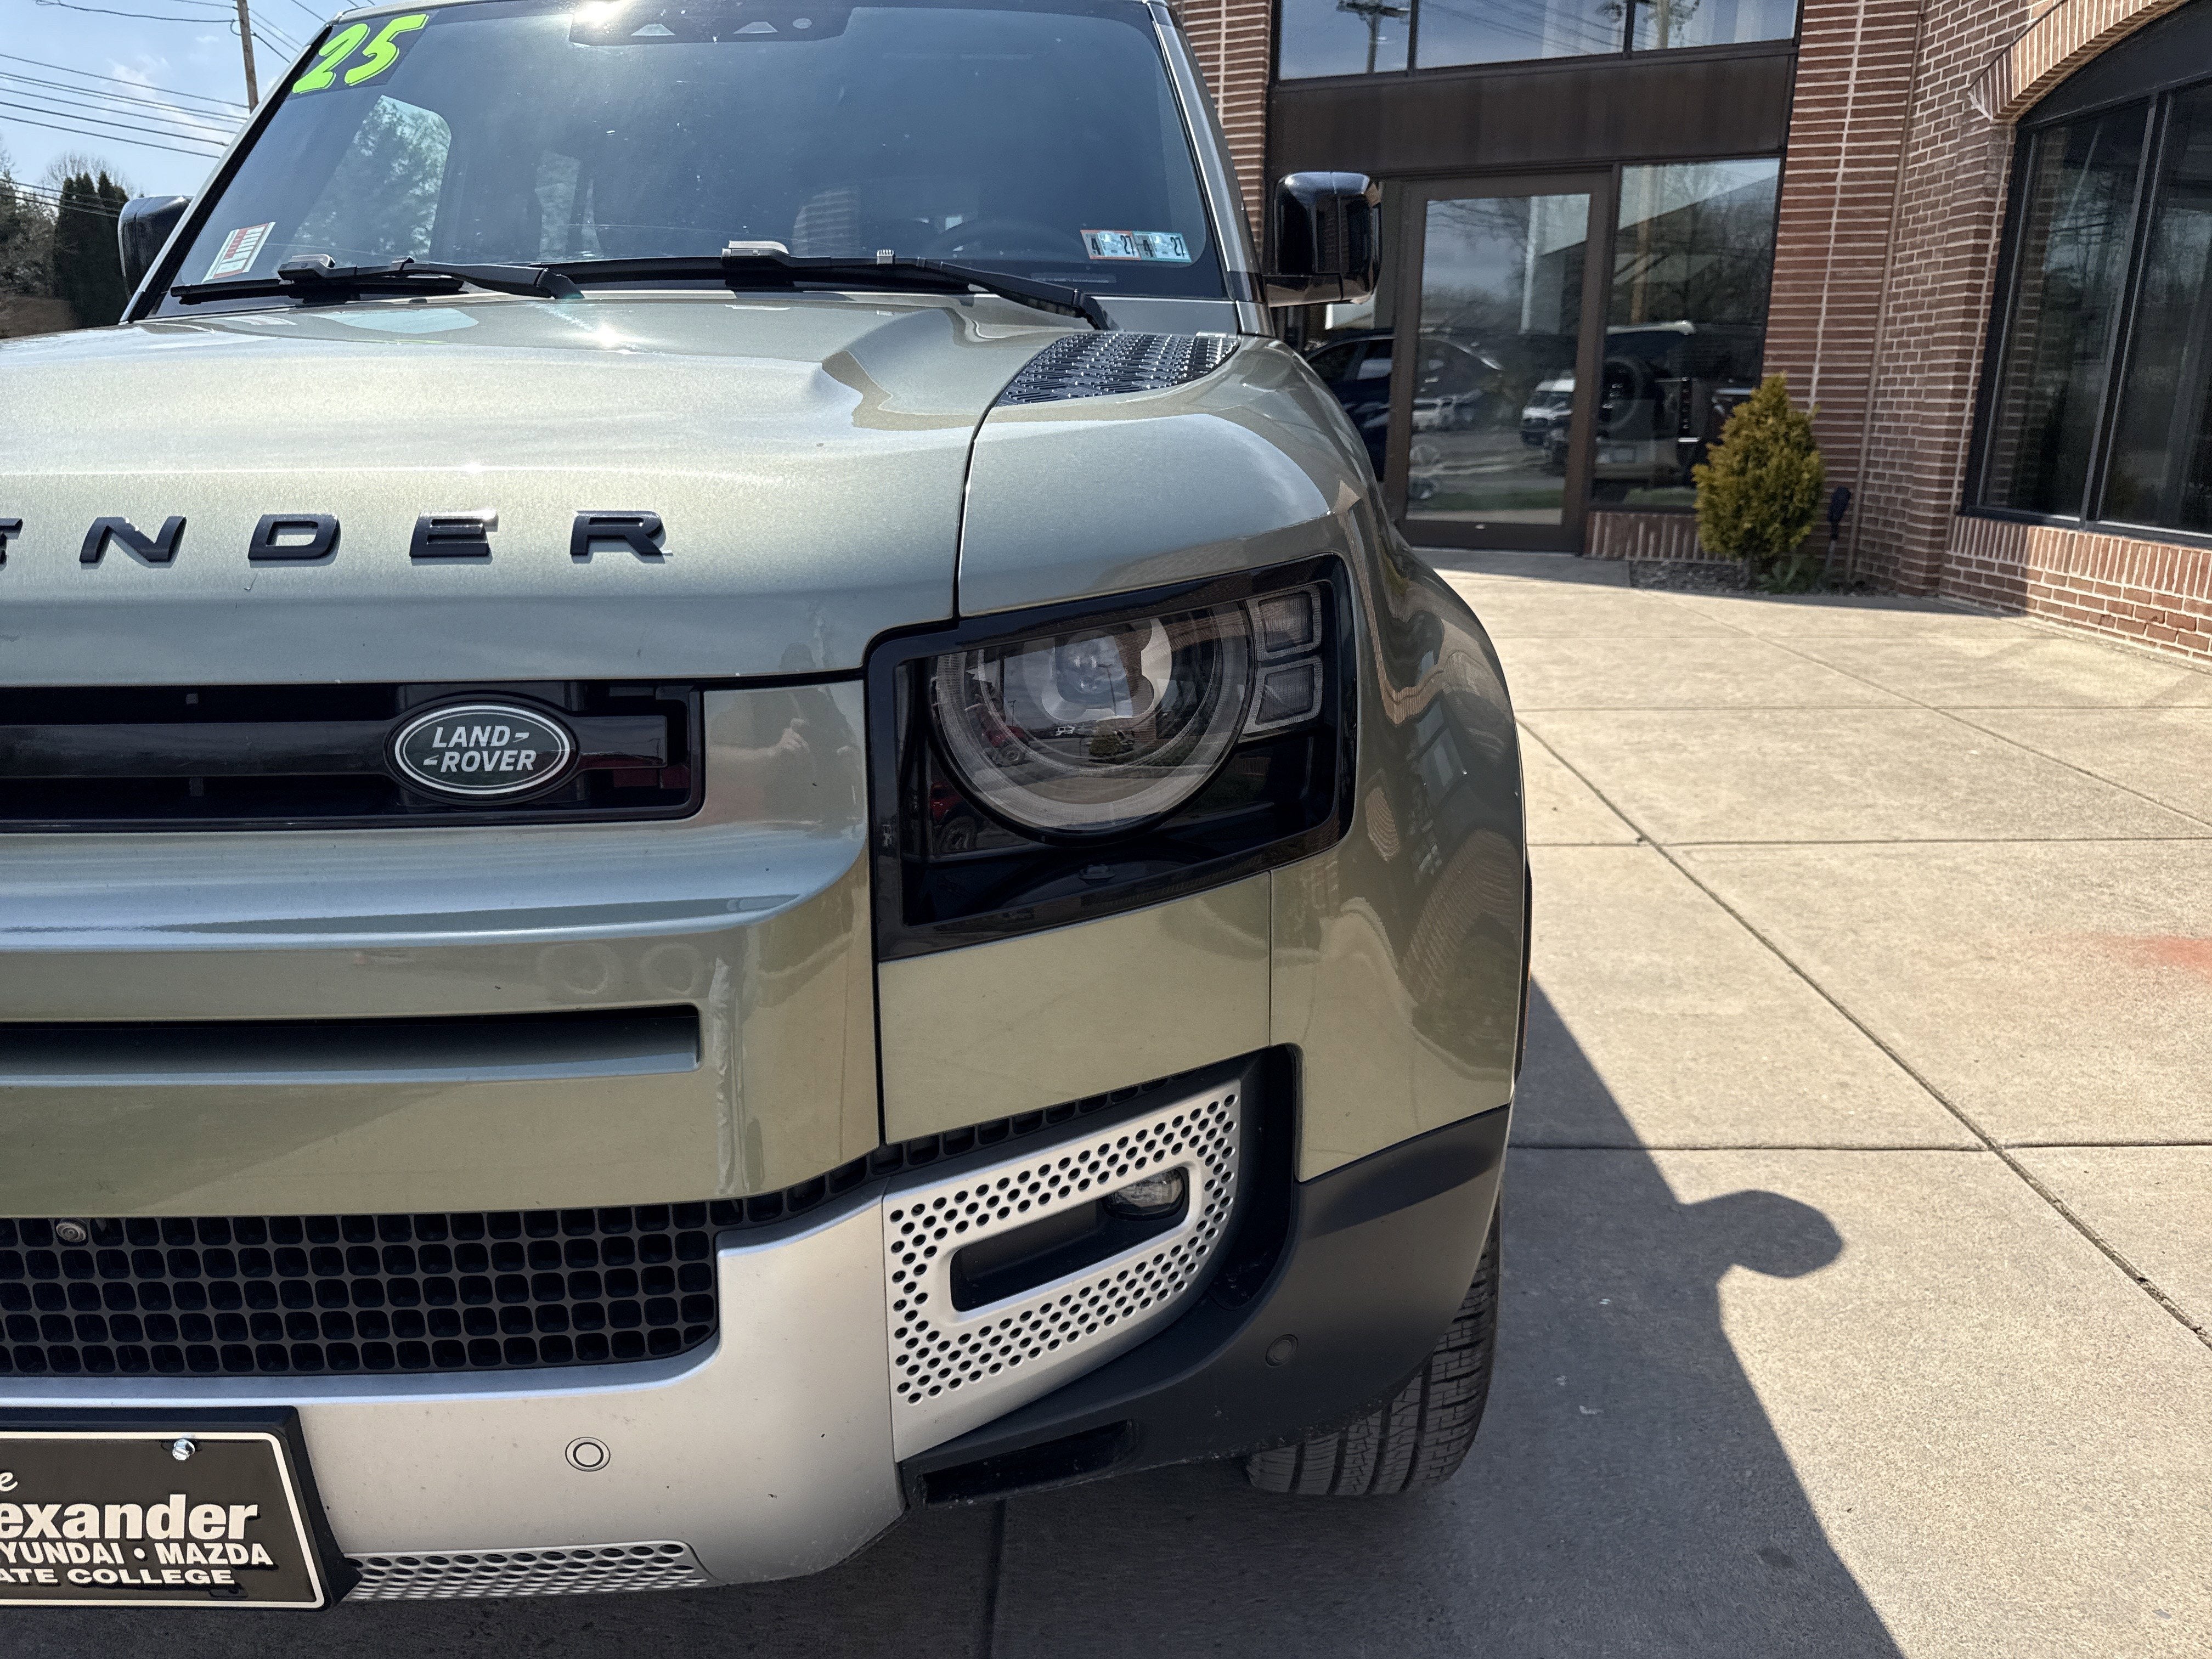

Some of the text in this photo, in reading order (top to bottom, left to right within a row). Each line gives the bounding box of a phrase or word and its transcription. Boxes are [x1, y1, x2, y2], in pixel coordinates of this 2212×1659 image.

[292, 14, 429, 94] 25
[1091, 235, 1135, 257] 4 27
[1143, 236, 1186, 258] 4 27
[0, 510, 667, 564] NDER
[432, 725, 511, 748] LAND
[440, 749, 537, 772] ROVER
[0, 1494, 258, 1539] exander
[0, 1542, 274, 1565] YUNDAI MAZDA
[67, 1568, 235, 1584] COLLEGE
